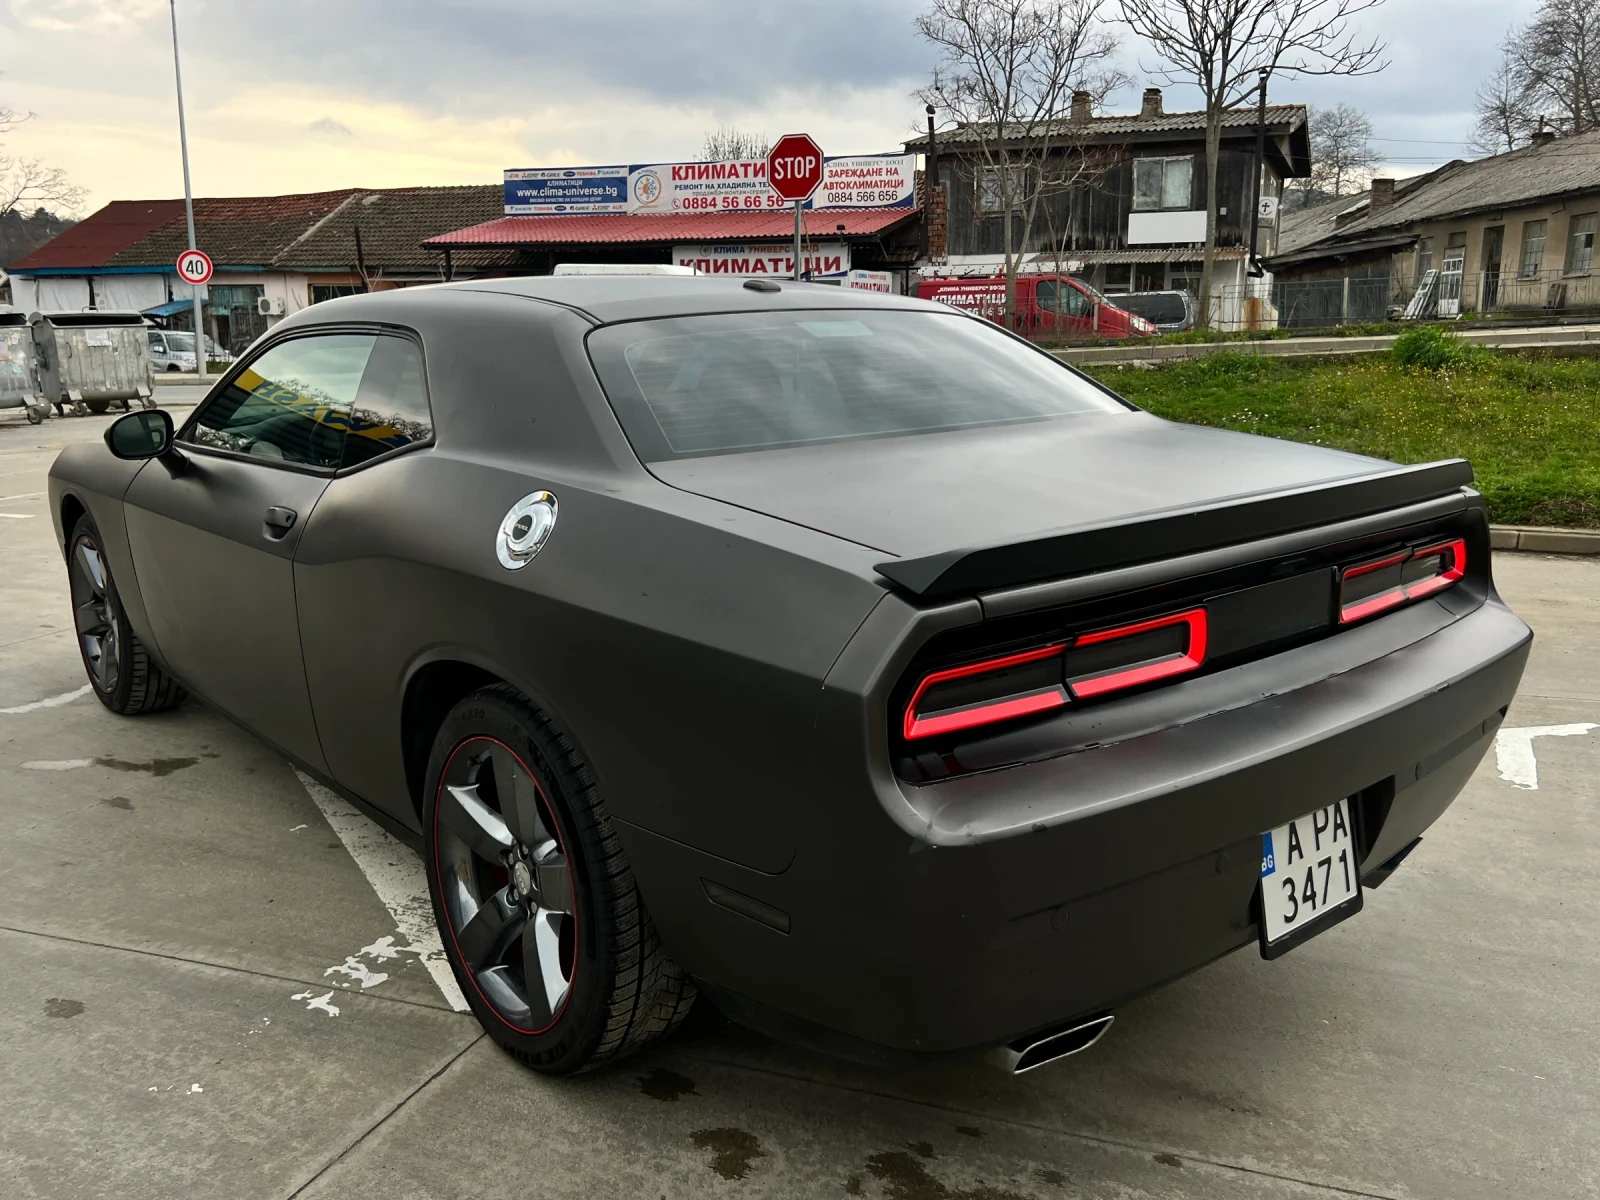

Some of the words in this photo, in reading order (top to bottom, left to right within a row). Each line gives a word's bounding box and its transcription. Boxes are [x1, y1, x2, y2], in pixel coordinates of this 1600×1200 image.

[671, 162, 766, 181] КЛИМАТИ
[774, 155, 816, 180] STOP
[828, 168, 883, 178] ЗАРЕЖДАНЕ
[885, 167, 899, 177] НА
[546, 179, 583, 187] КЛИМАТИЦИ
[674, 183, 703, 191] РЕМОНТ
[705, 182, 715, 190] НА
[717, 181, 757, 190] ХЛАДИЛНА
[822, 178, 904, 190] АВТОКЛИМАТИЦИ
[516, 185, 618, 197] www.clima-universe.bg
[825, 191, 853, 203] 0884
[856, 191, 876, 203] 566
[878, 190, 898, 202] 656
[682, 196, 718, 210] 0884
[721, 196, 740, 209] 56
[743, 195, 762, 208] 66
[766, 195, 785, 208] 56
[713, 246, 746, 254] КЛИМА
[748, 244, 791, 254] УНИВЕРС
[185, 259, 204, 275] 40
[1288, 821, 1304, 866] A
[1312, 802, 1349, 852] PA
[1261, 854, 1274, 872] BG
[1281, 847, 1352, 924] 3471
